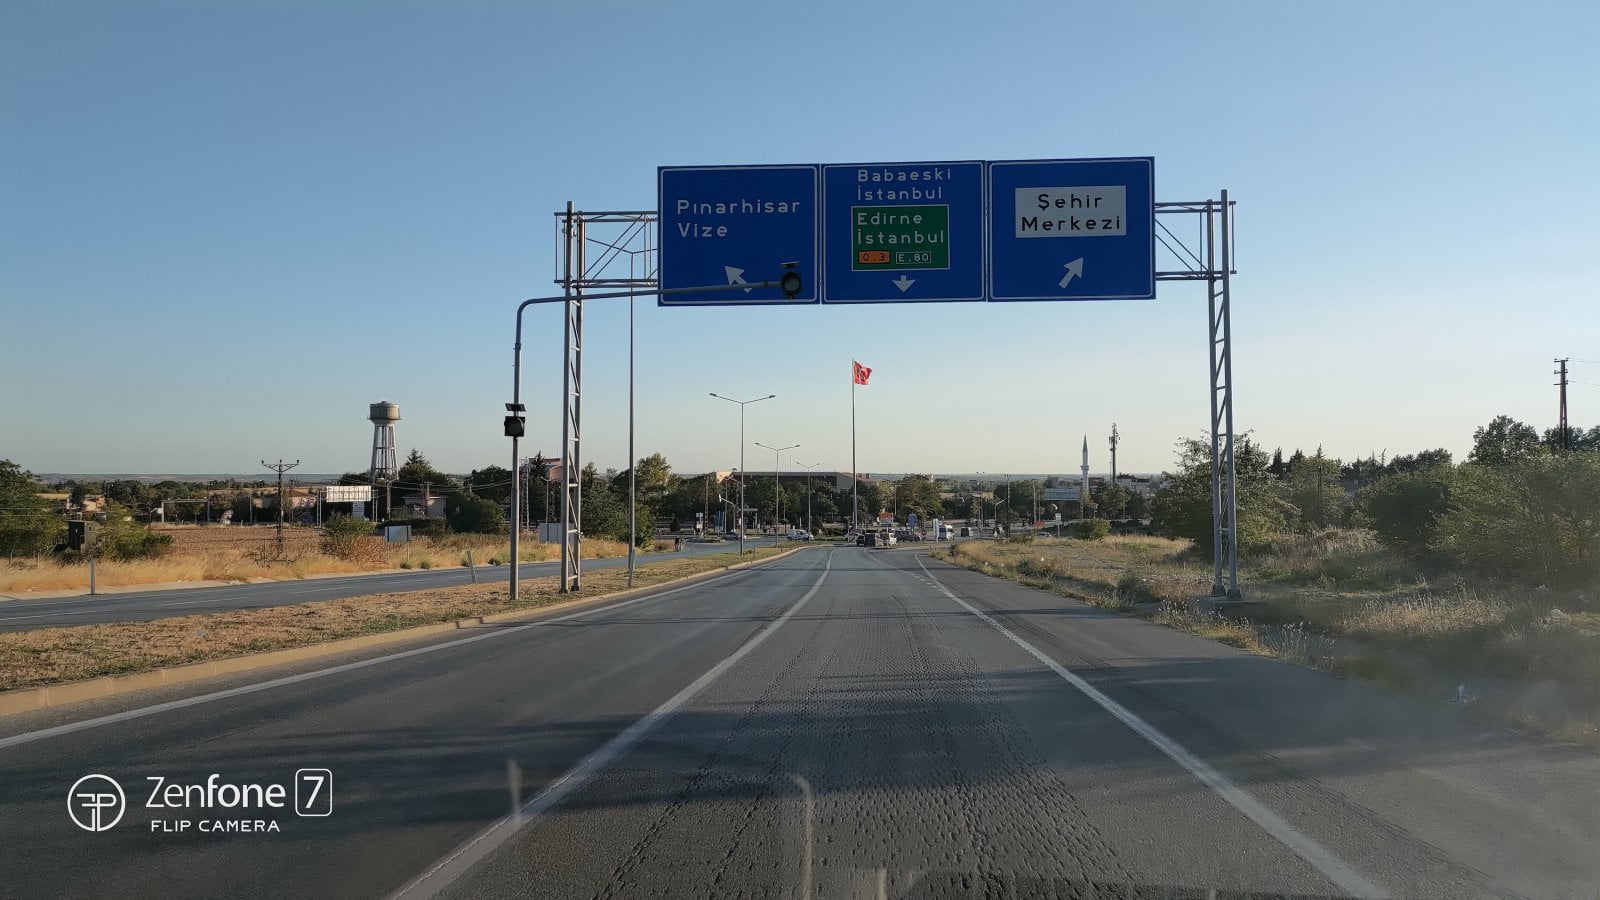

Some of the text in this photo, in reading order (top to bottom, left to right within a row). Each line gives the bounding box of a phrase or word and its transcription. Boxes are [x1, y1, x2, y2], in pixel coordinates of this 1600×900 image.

[857, 168, 952, 183] Babaeski
[857, 185, 943, 201] İstanbul
[677, 198, 801, 215] Pınarhisar
[1037, 193, 1103, 211] Şehir
[857, 212, 923, 226] Edirne
[1021, 216, 1120, 232] Merkezi
[678, 222, 728, 238] Vize
[858, 229, 944, 244] İstanbul
